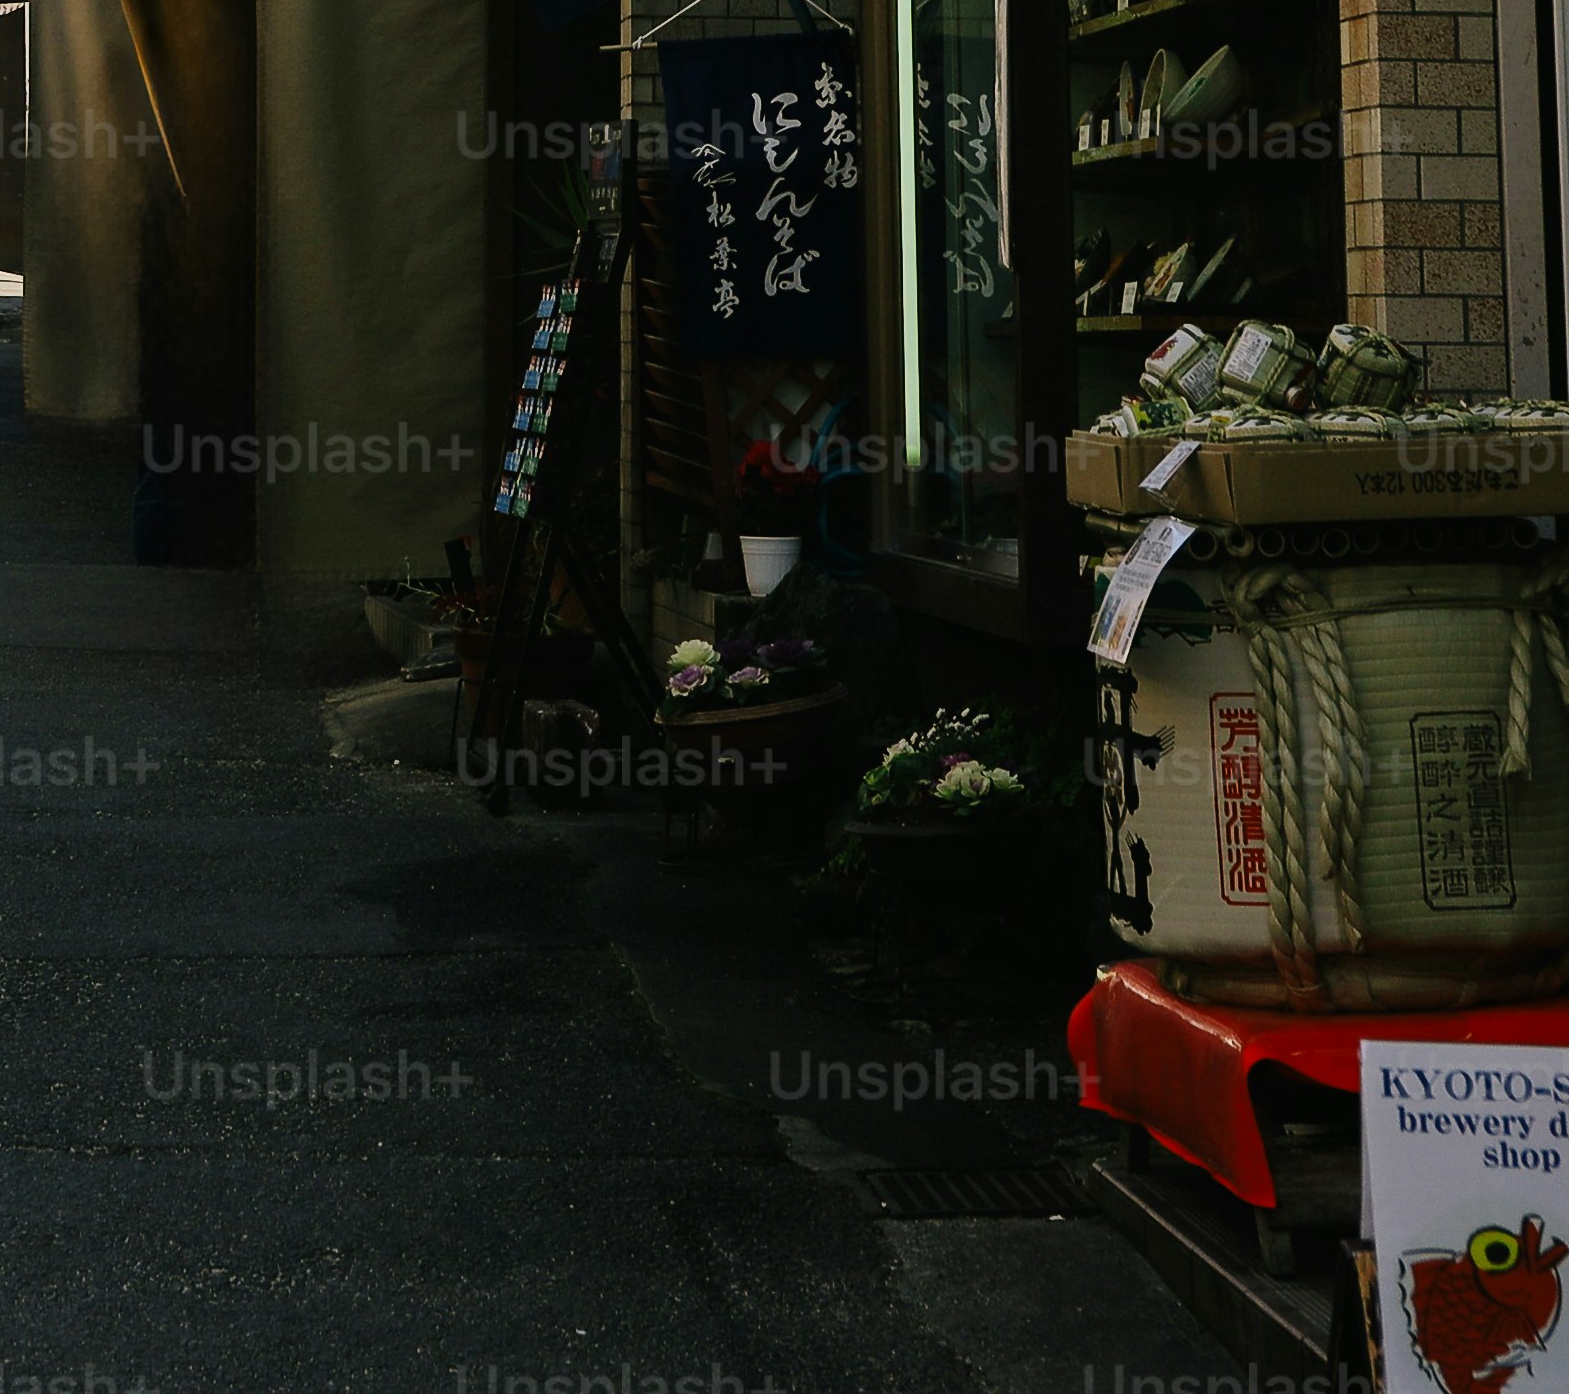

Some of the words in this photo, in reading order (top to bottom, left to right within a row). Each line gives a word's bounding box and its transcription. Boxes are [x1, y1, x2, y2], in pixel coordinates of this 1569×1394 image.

[706, 190, 741, 320] 松葉亭
[1396, 1105, 1535, 1140] brewery
[1482, 1141, 1562, 1174] shop
